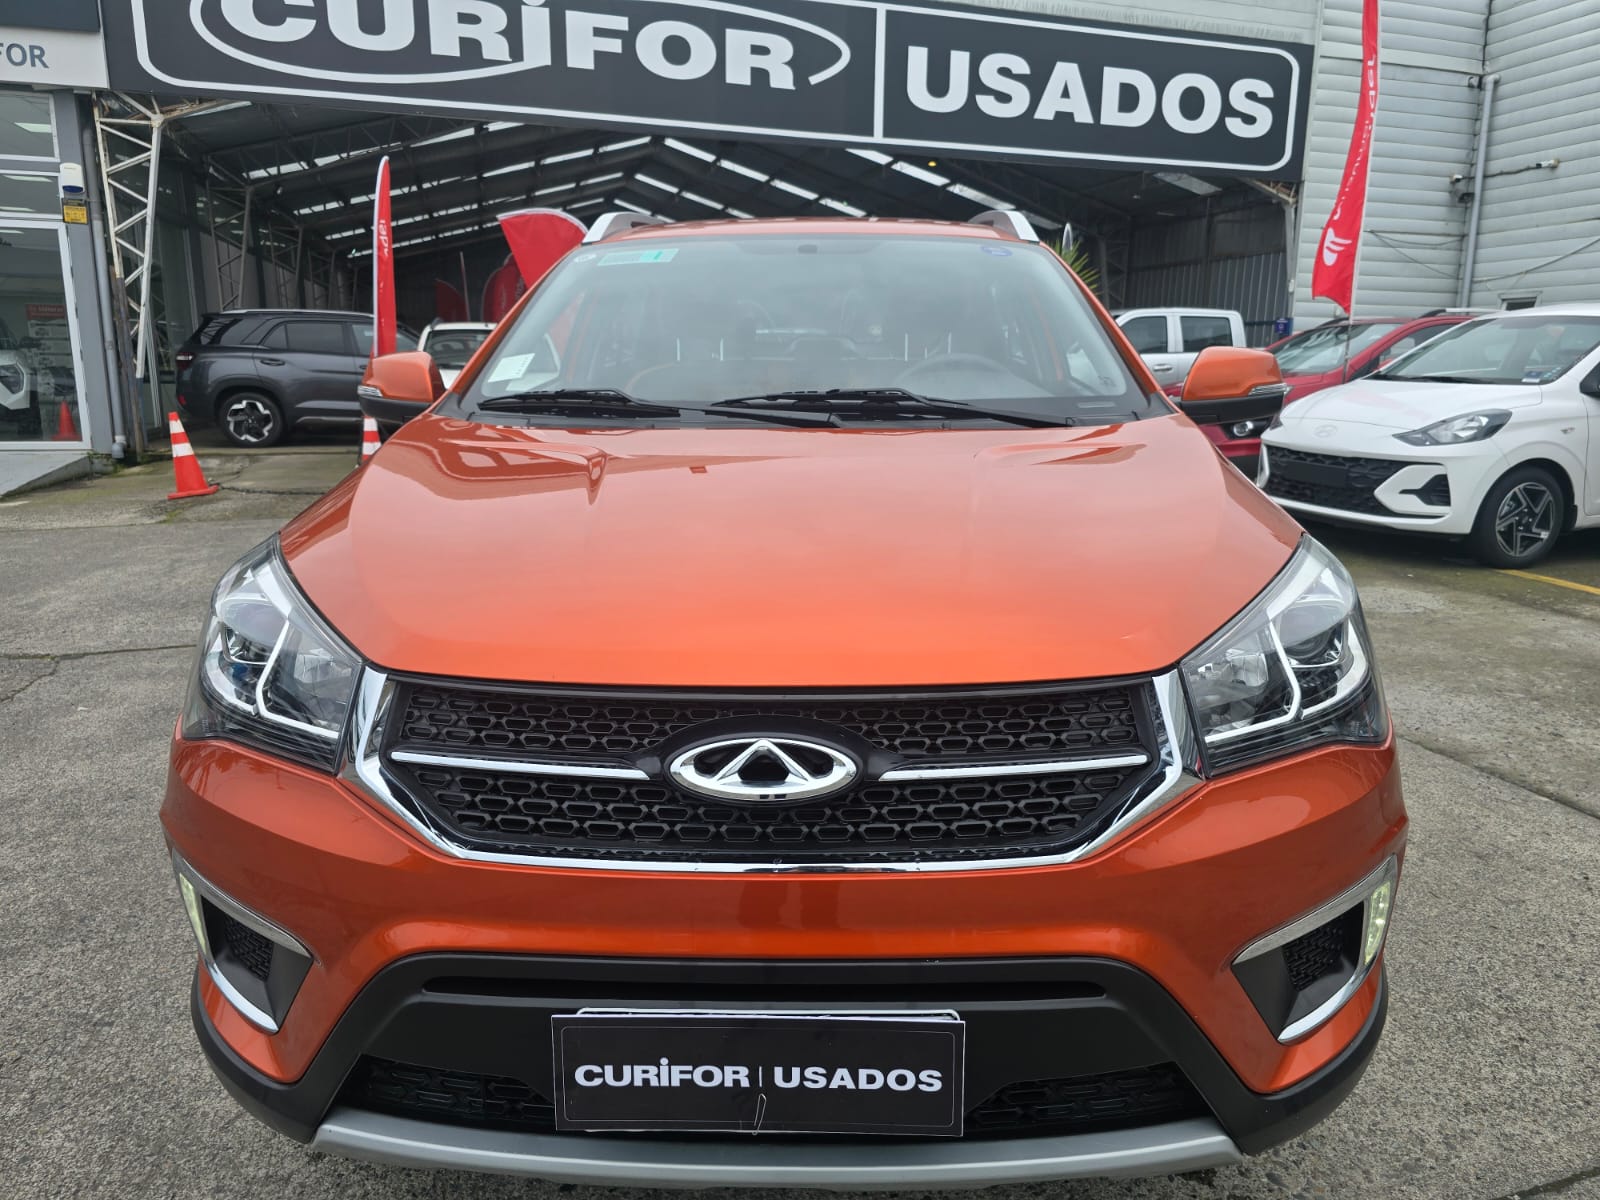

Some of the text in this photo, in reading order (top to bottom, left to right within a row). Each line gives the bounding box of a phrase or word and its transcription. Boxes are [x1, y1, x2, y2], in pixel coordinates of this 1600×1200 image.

[0, 42, 49, 68] OR
[906, 45, 1274, 138] USADOS
[773, 1066, 943, 1092] USADOS
